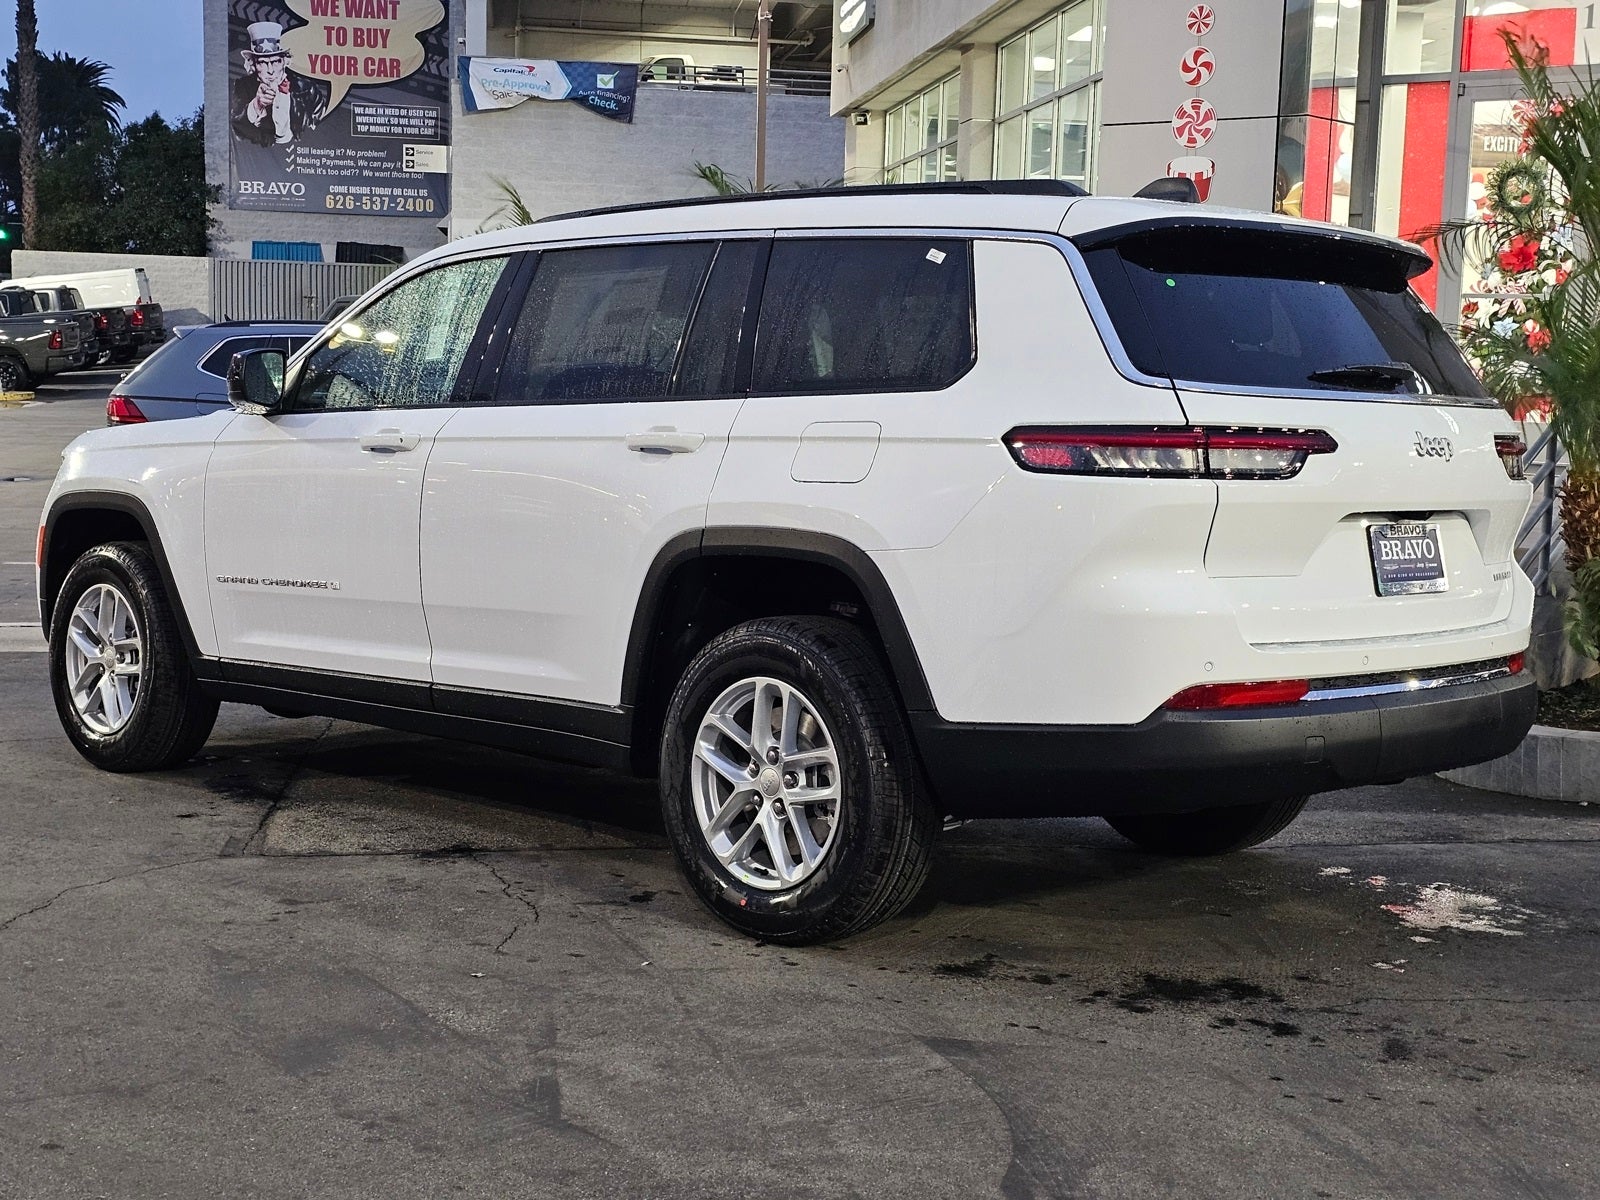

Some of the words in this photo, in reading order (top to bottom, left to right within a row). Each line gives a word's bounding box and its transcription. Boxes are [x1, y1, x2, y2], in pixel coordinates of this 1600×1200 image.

[311, 0, 339, 17] WE
[344, 0, 400, 20] WANT
[324, 26, 347, 46] TO
[353, 28, 390, 48] BUY
[308, 54, 358, 76] YOUR
[364, 57, 400, 78] CAR
[481, 78, 552, 94] Pre-Approval
[589, 96, 619, 110] Check.
[597, 90, 630, 103] financing?
[385, 108, 399, 116] NEED
[408, 109, 423, 117] USED
[410, 118, 424, 126] WILL
[370, 125, 390, 133] MONEY
[391, 126, 402, 134] FOR
[1483, 136, 1518, 152] EXCITI
[296, 146, 309, 154] Still
[311, 147, 334, 157] leasing
[336, 148, 345, 156] it?
[357, 150, 387, 158] problem!
[296, 157, 320, 166] Making
[297, 166, 315, 174] Think
[239, 181, 306, 195] BRAVO
[329, 185, 348, 193] COME
[349, 186, 370, 194] INSIDE
[371, 187, 391, 195] TODAY
[403, 188, 418, 196] CALL
[325, 194, 434, 213] 626-537-2400
[1413, 431, 1454, 462] Jeep
[1390, 525, 1421, 536] BRAVO
[1379, 538, 1435, 560] BRAVO
[216, 575, 259, 585] GRAND
[261, 578, 328, 589] CHEROKEE
